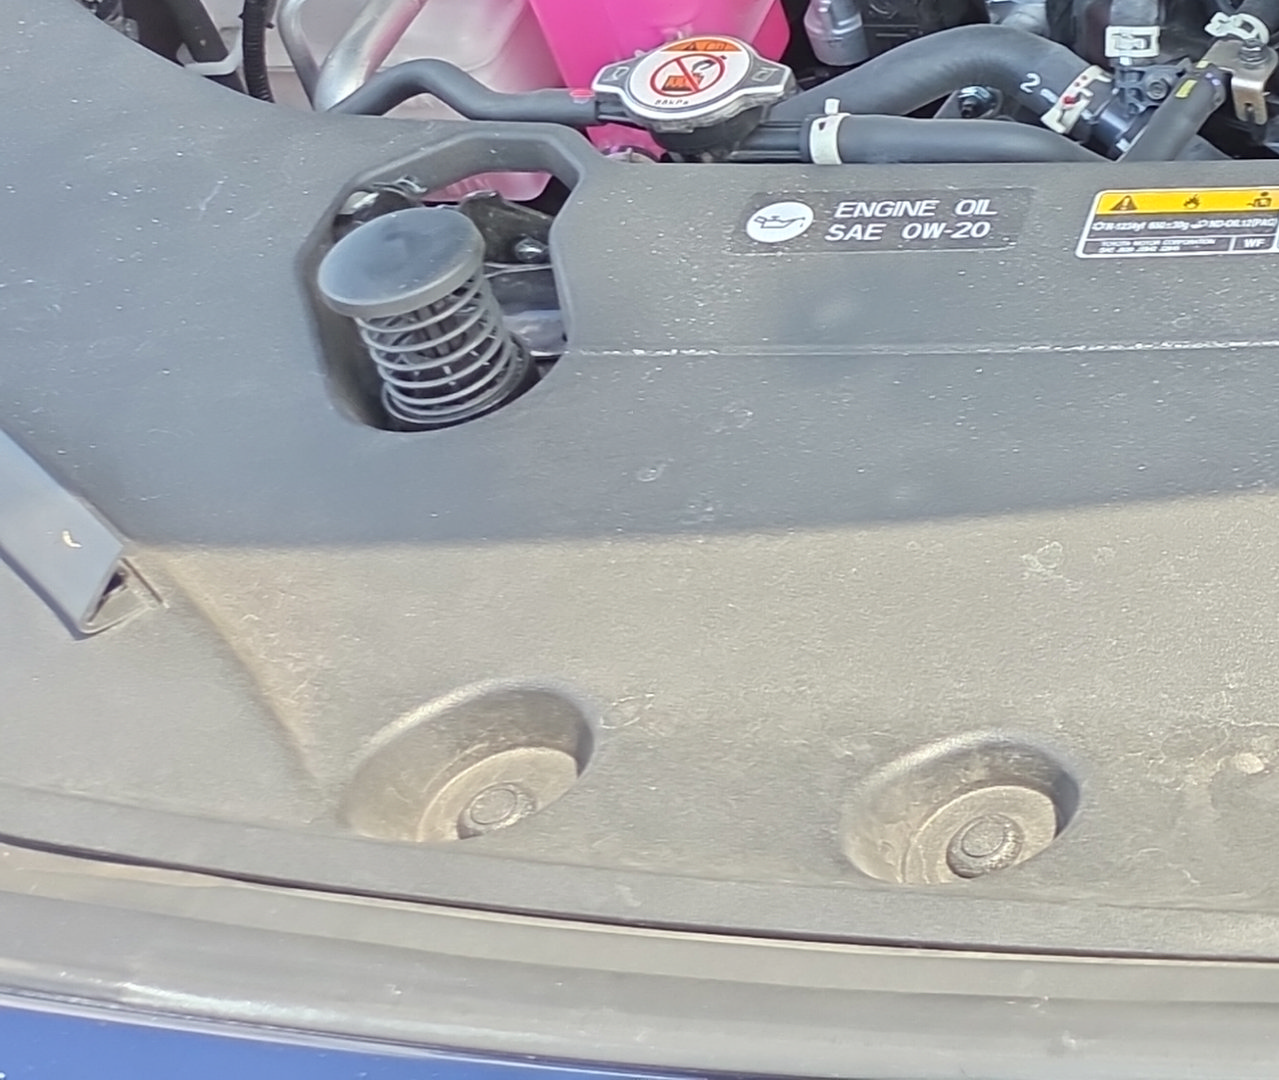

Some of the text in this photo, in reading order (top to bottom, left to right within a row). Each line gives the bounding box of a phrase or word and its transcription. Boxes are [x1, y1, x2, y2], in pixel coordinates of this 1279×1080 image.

[834, 198, 999, 218] ENGINE OIL
[824, 220, 991, 241] SAE 0W-20
[1243, 238, 1267, 249] WF
